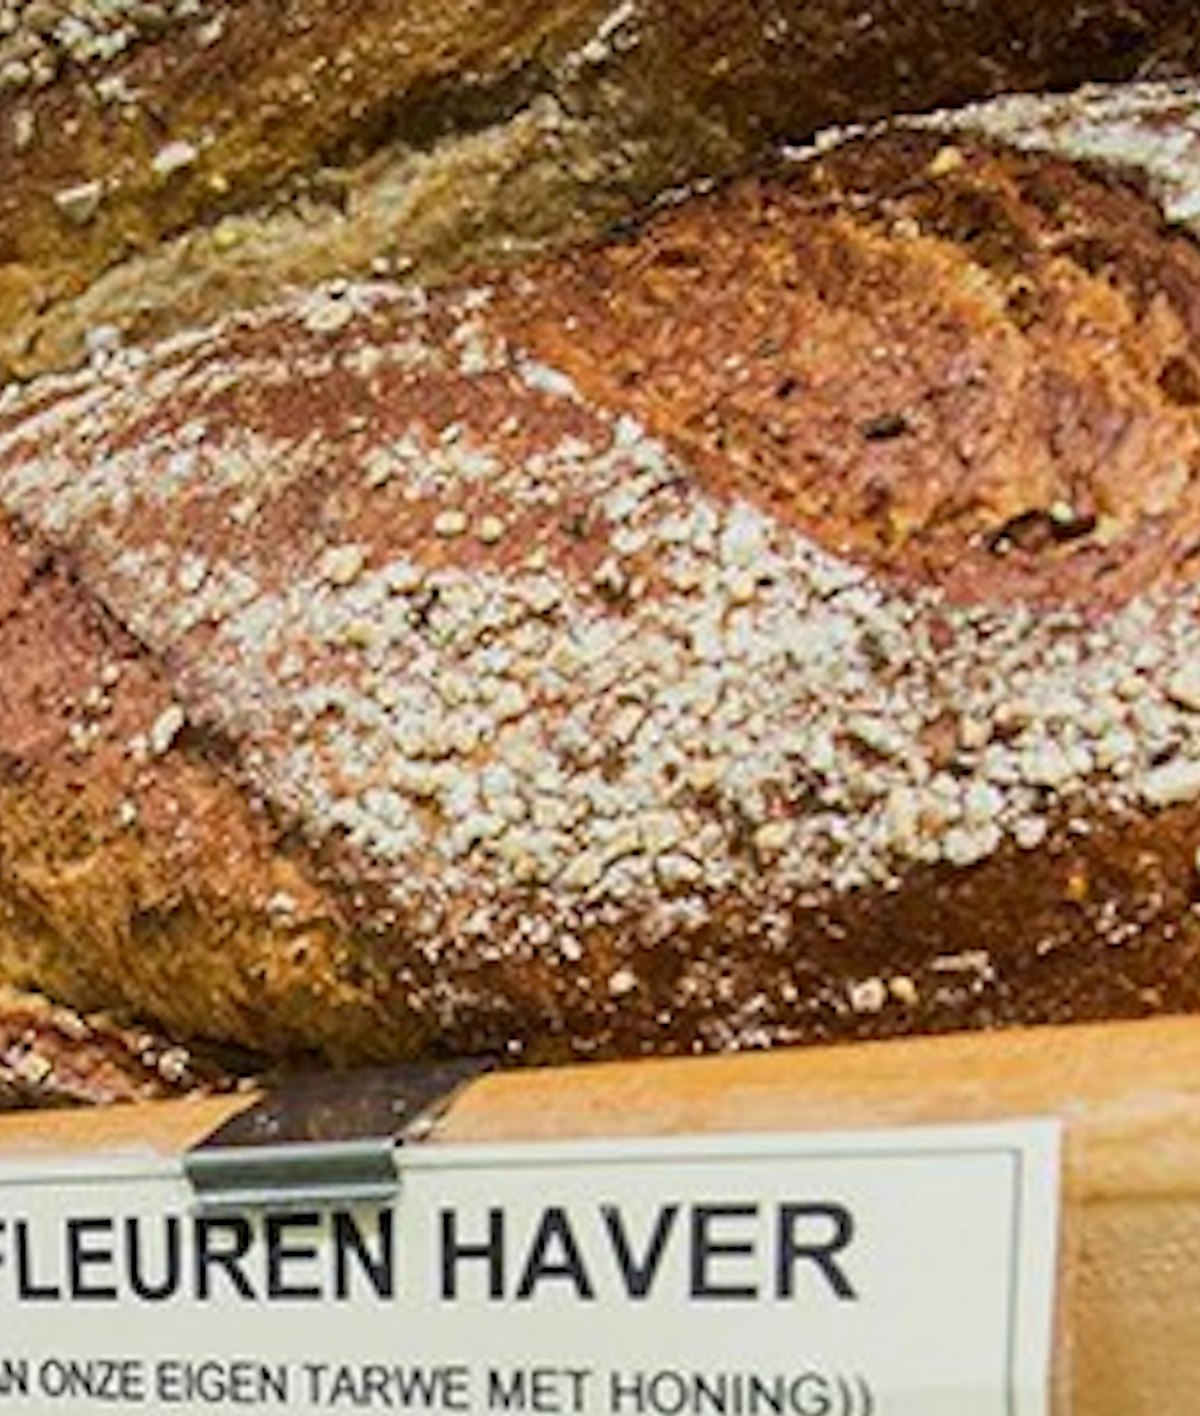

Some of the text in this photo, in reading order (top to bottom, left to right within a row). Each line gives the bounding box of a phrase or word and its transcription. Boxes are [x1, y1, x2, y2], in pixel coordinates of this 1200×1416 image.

[440, 1202, 858, 1300] HAVER
[39, 1359, 145, 1400] ONZE
[157, 1360, 288, 1403] EIGEN
[303, 1365, 469, 1409] TARWE
[488, 1368, 592, 1413] MET
